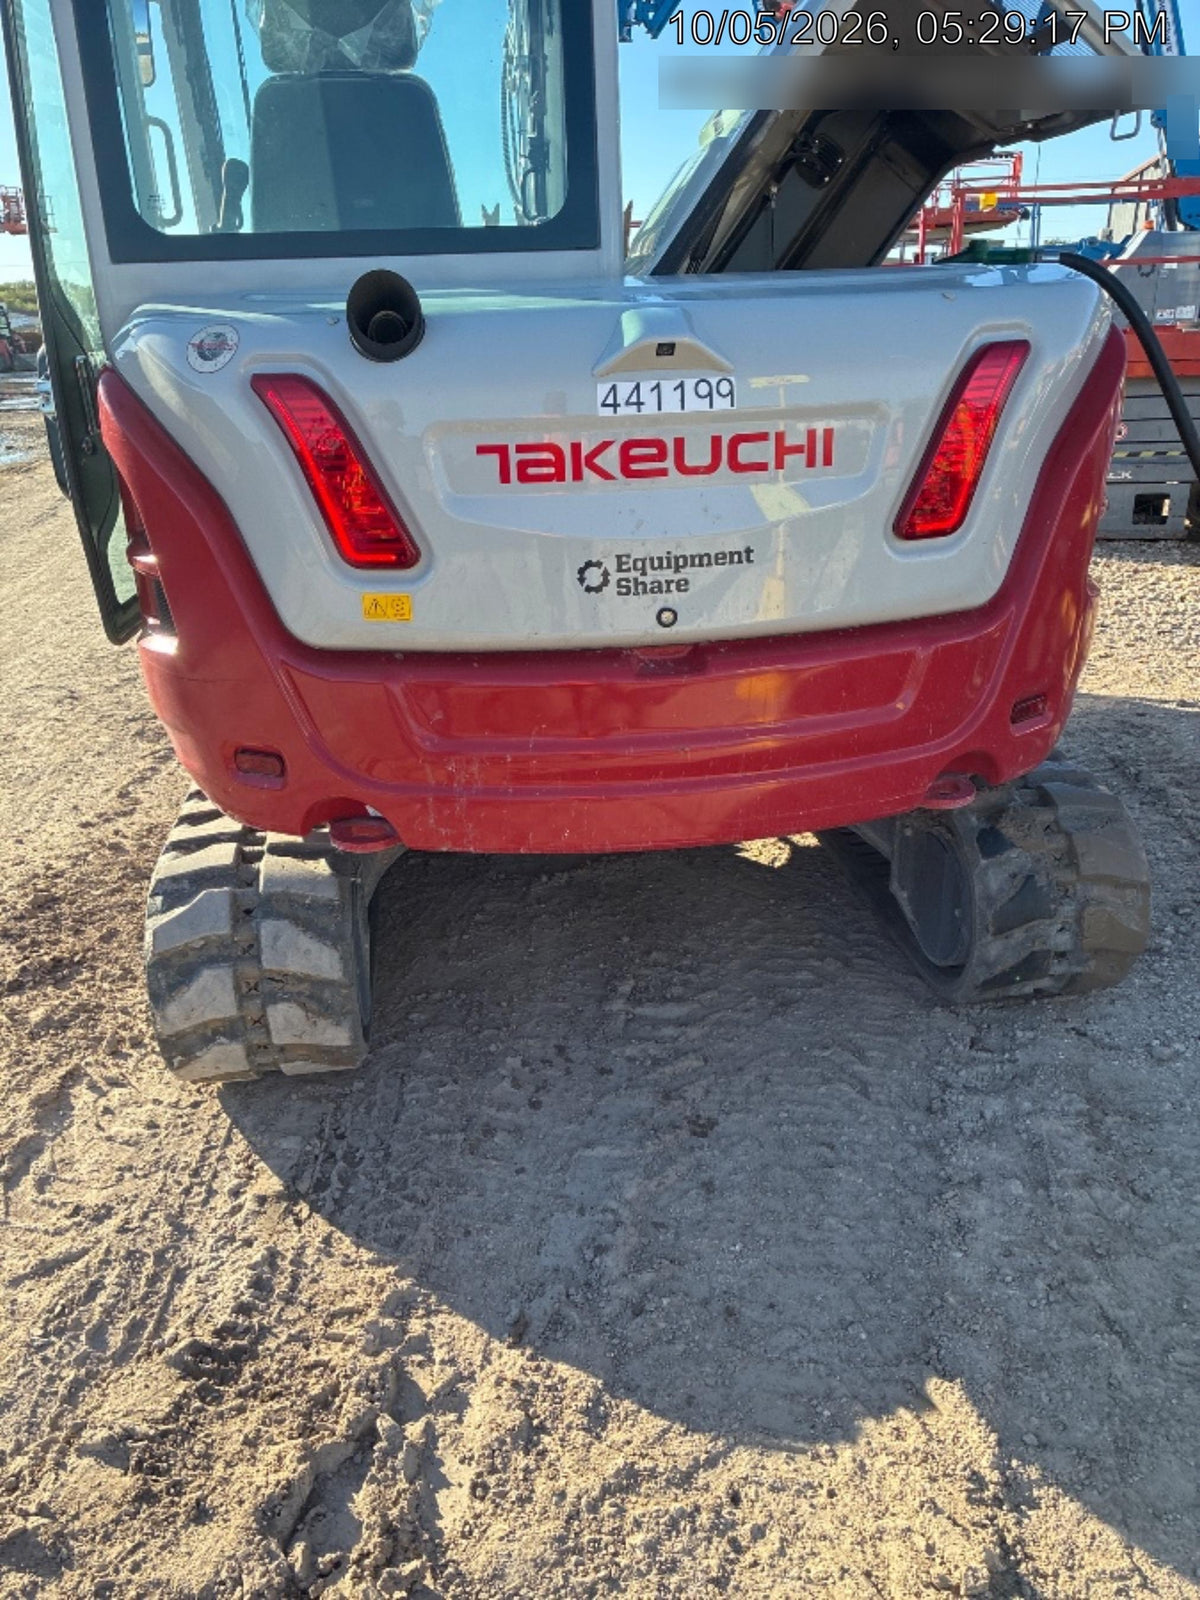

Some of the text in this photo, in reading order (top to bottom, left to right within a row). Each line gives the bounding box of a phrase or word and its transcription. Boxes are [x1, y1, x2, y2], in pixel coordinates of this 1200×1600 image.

[600, 378, 735, 414] 441199
[615, 546, 754, 576] Equipment
[616, 578, 690, 596] Share
